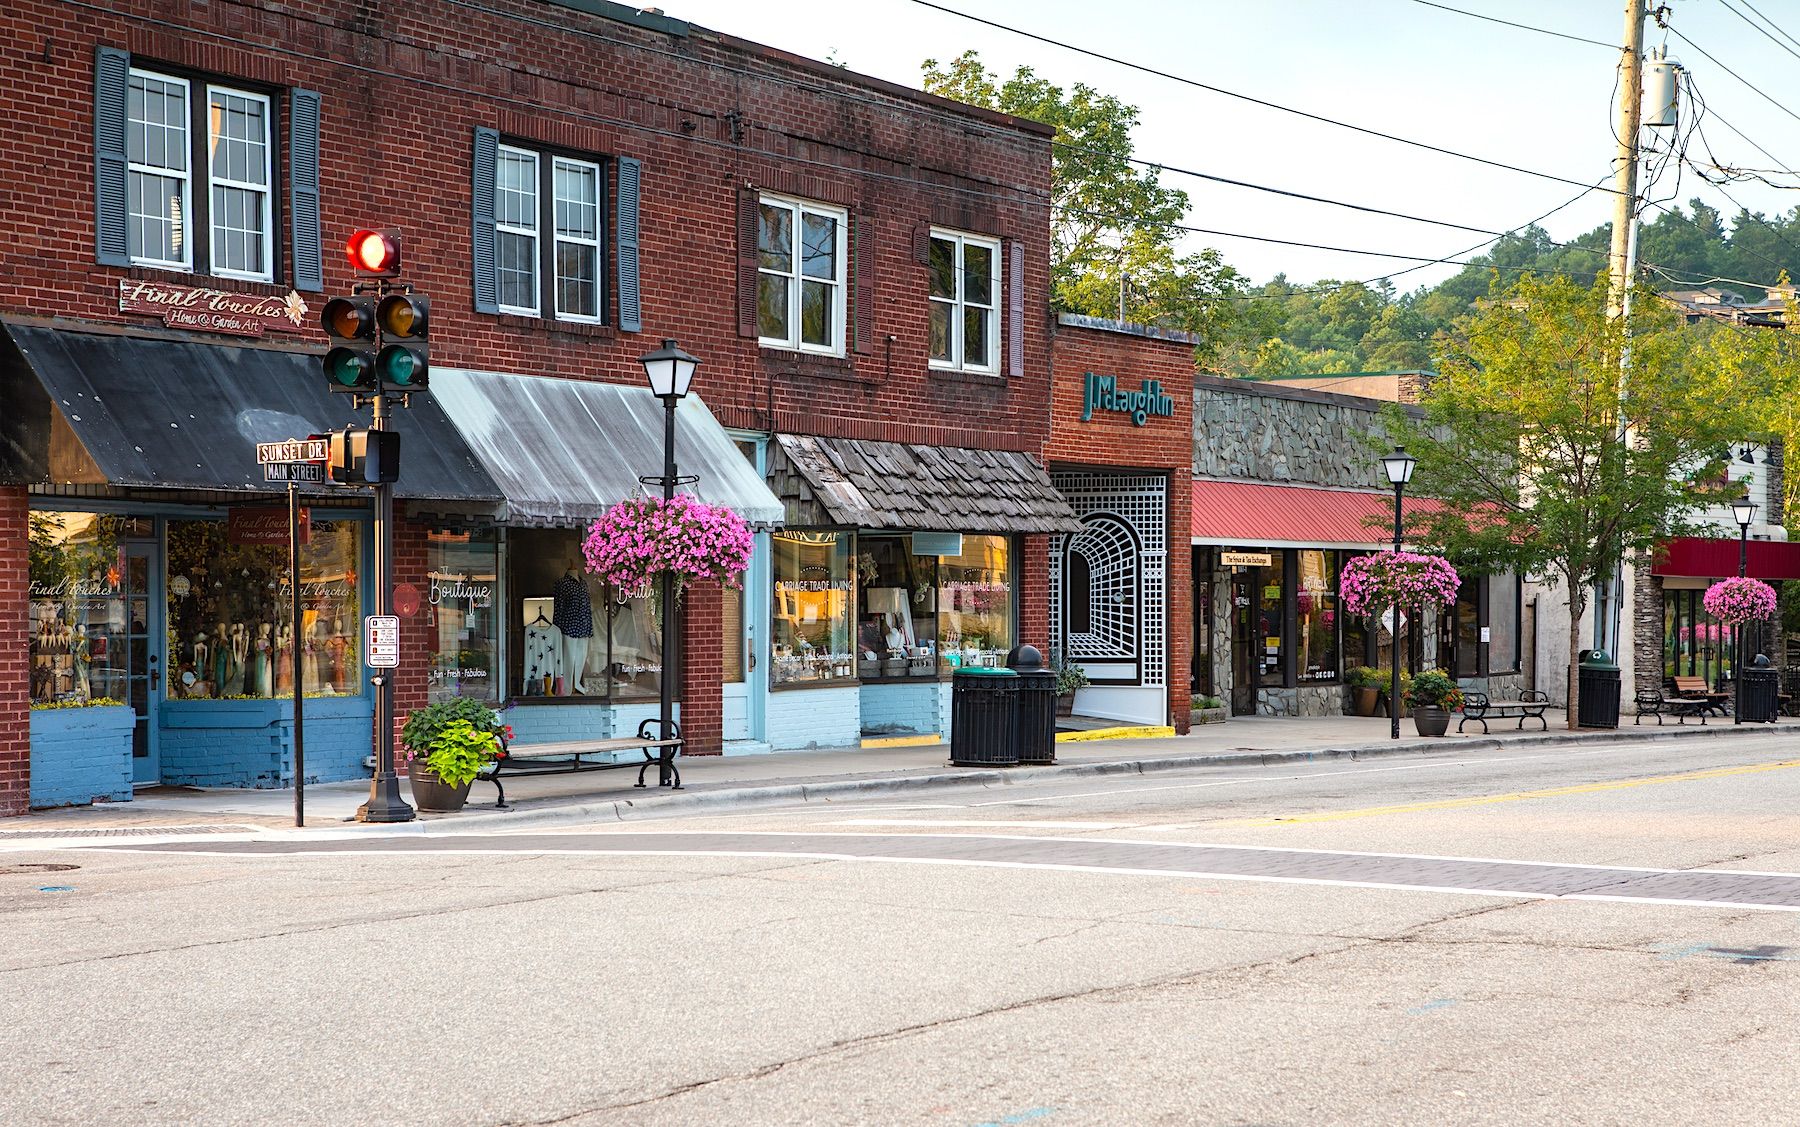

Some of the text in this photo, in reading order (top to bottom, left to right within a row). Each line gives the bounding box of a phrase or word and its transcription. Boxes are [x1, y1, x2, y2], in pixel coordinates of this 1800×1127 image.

[129, 282, 282, 318] Final Touches
[170, 310, 197, 324] Home
[211, 315, 241, 330] Garden
[241, 318, 259, 332] Art
[261, 442, 325, 461] SUNSET DR.
[267, 464, 320, 481] MAIN STREET
[233, 514, 290, 528] Final Touch
[265, 531, 284, 539] Garden
[28, 575, 112, 596] Final Touches
[279, 579, 350, 596] Fil Touches
[428, 571, 491, 616] Boutique
[775, 580, 853, 592] CARRIAGE TRADE LIVING
[942, 581, 1011, 592] CARRIAGE TRADE LIVING
